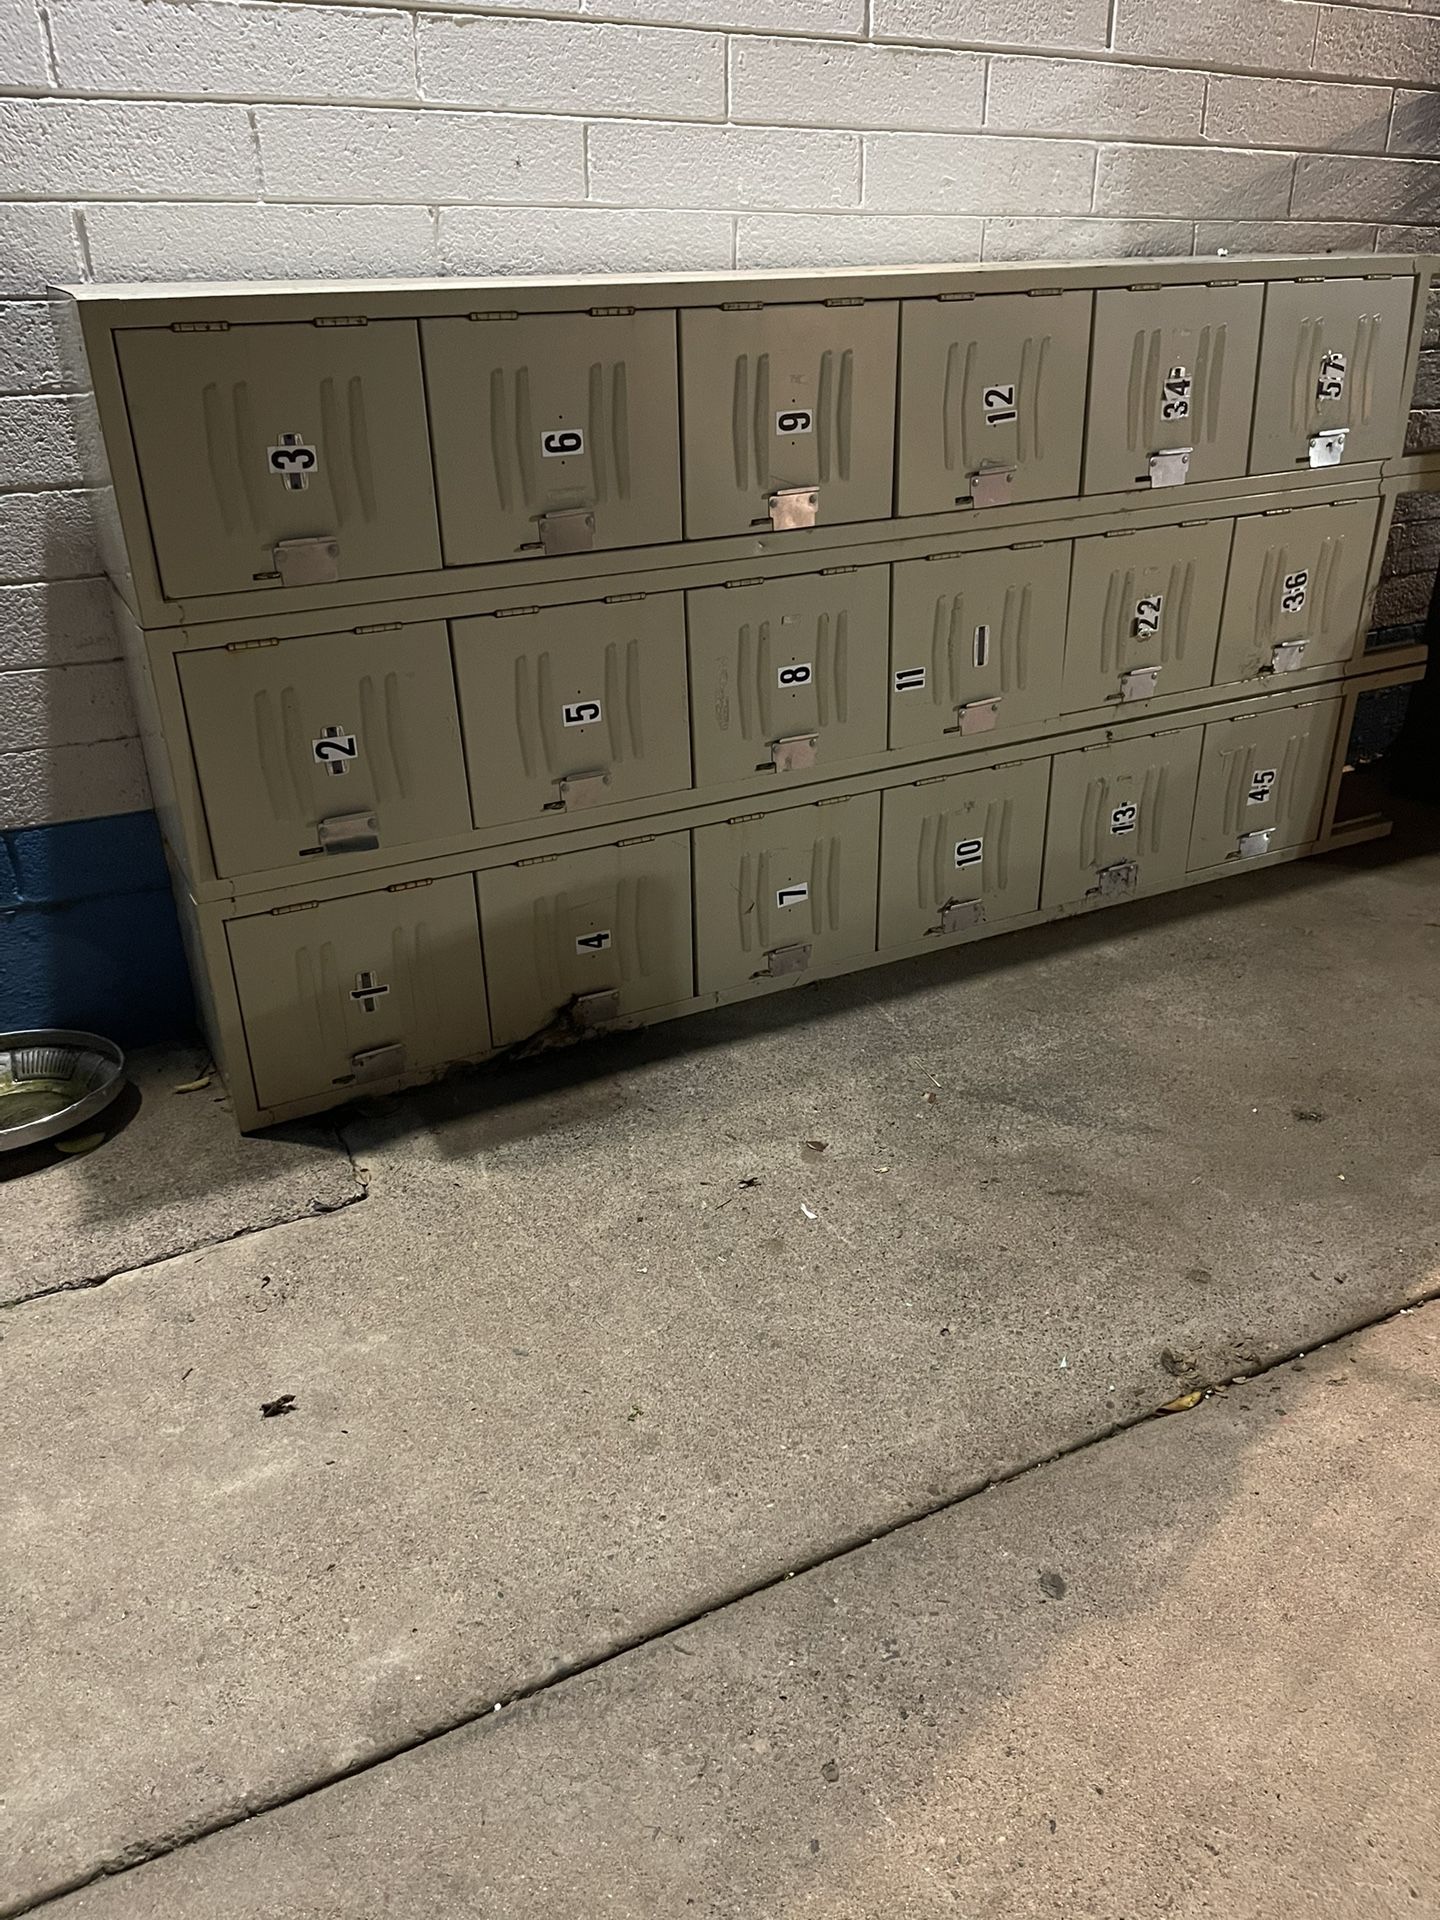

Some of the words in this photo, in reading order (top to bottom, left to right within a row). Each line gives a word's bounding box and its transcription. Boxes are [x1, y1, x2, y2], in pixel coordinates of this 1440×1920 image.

[1318, 357, 1344, 399] 57
[985, 386, 1015, 424] 12
[1164, 379, 1190, 418] 34
[778, 413, 811, 430] 9
[544, 433, 581, 452] 6
[272, 448, 315, 469] 3
[1283, 571, 1307, 611] 36
[1138, 596, 1162, 635] 22
[780, 667, 810, 683] 8
[896, 667, 925, 690] 11
[565, 704, 599, 724] 5
[316, 737, 356, 760] 2
[1249, 770, 1275, 801] 45
[1113, 806, 1136, 833] 13
[957, 840, 981, 866] 10
[779, 888, 807, 904] 7
[578, 933, 609, 948] 4
[351, 985, 388, 998] 1
